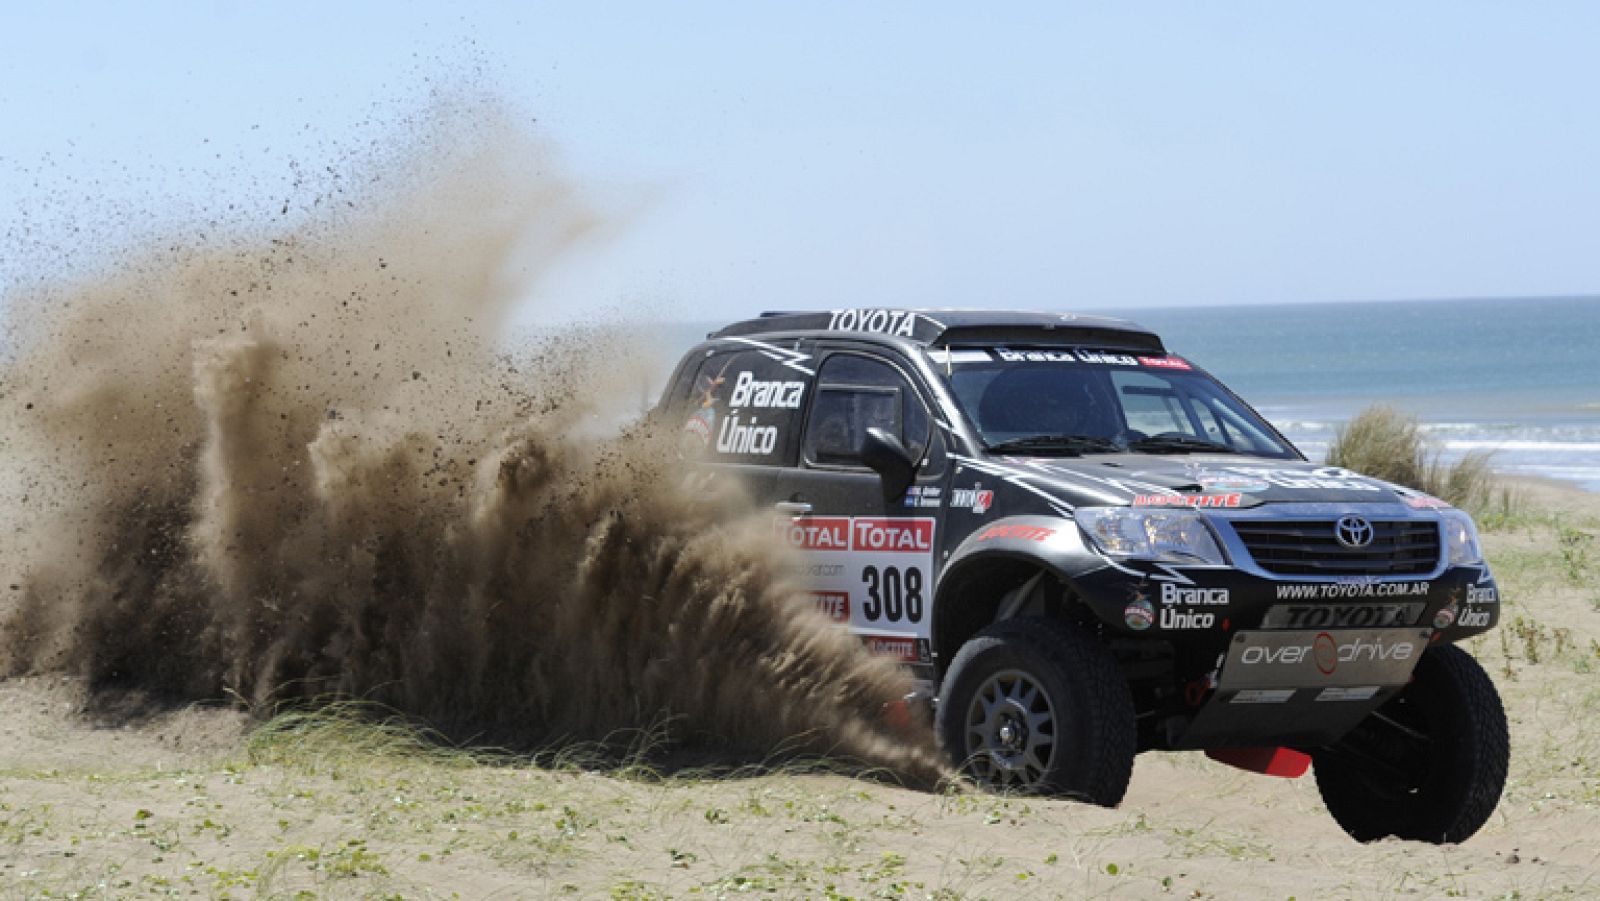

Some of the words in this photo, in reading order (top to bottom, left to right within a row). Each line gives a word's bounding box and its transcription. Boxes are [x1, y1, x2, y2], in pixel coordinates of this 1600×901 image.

[827, 308, 916, 337] TOYOTA
[729, 370, 805, 409] Branca
[716, 408, 778, 455] Único
[856, 523, 930, 549] TOTAL
[862, 565, 923, 622] 308
[1160, 583, 1230, 606] Branca
[1276, 582, 1430, 599] WWW.TOYOTA.COM.AR
[1160, 604, 1215, 629] Único
[1286, 605, 1411, 627] TOYOTA
